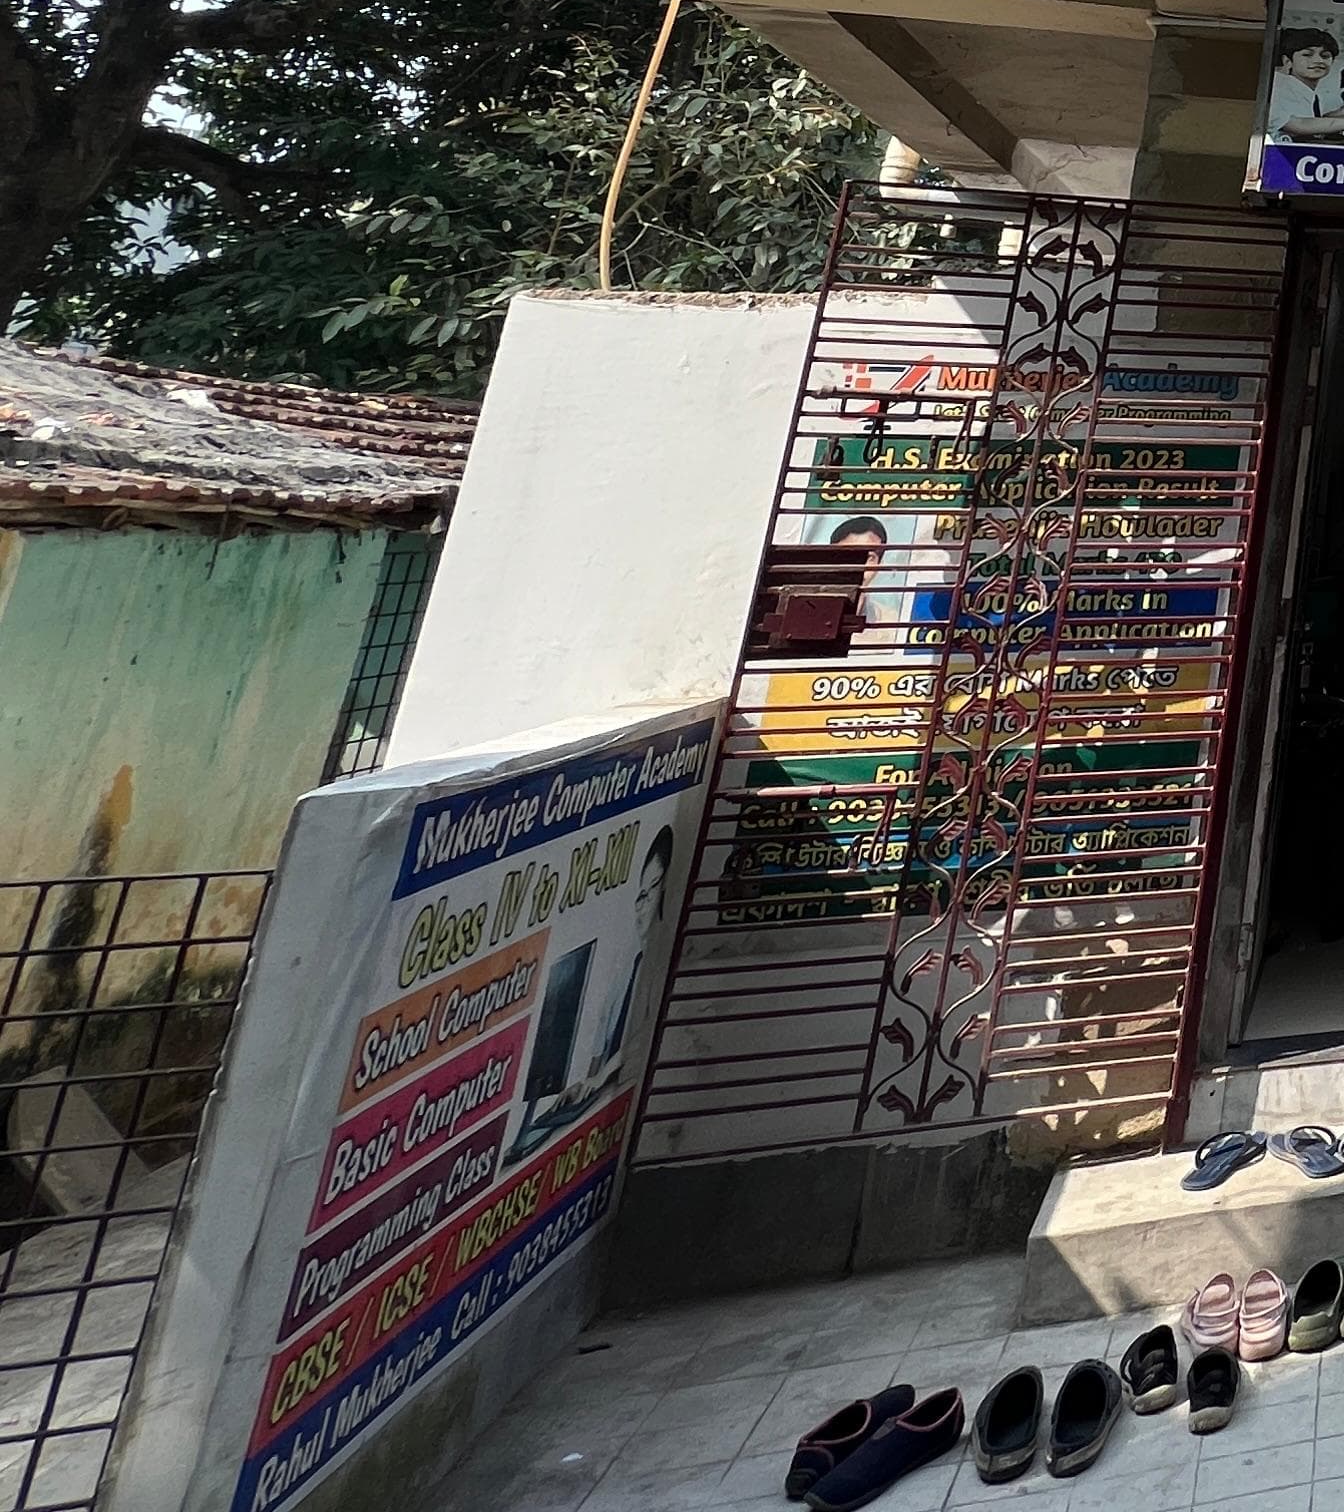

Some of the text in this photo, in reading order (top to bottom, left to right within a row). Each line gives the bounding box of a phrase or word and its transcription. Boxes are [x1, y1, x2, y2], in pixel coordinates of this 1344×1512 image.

[1104, 363, 1238, 399] Academy
[870, 446, 1184, 472] H.S. Examitin 2023
[821, 476, 1219, 507] Computer ppicion Result
[1080, 512, 1224, 538] Howlader
[967, 553, 1035, 577] Totl
[1141, 589, 1167, 611] in
[812, 676, 881, 700] 90%
[888, 673, 937, 697] এর
[1016, 668, 1099, 692] Mrks
[875, 765, 920, 785] For
[413, 735, 710, 875] Mukherjee Computer Academy
[828, 794, 1000, 824] 90355313
[399, 895, 488, 988] Class
[489, 861, 536, 946] IV
[527, 863, 559, 928] to
[354, 959, 537, 1091] School Computer
[323, 1052, 512, 1206] Basic Computer
[293, 1145, 496, 1318] Programming Class
[270, 1100, 626, 1425] CBSE ICSE WBCHSE WB Board
[252, 1174, 614, 1510] Rahul Mukherjee Call 9038455313
